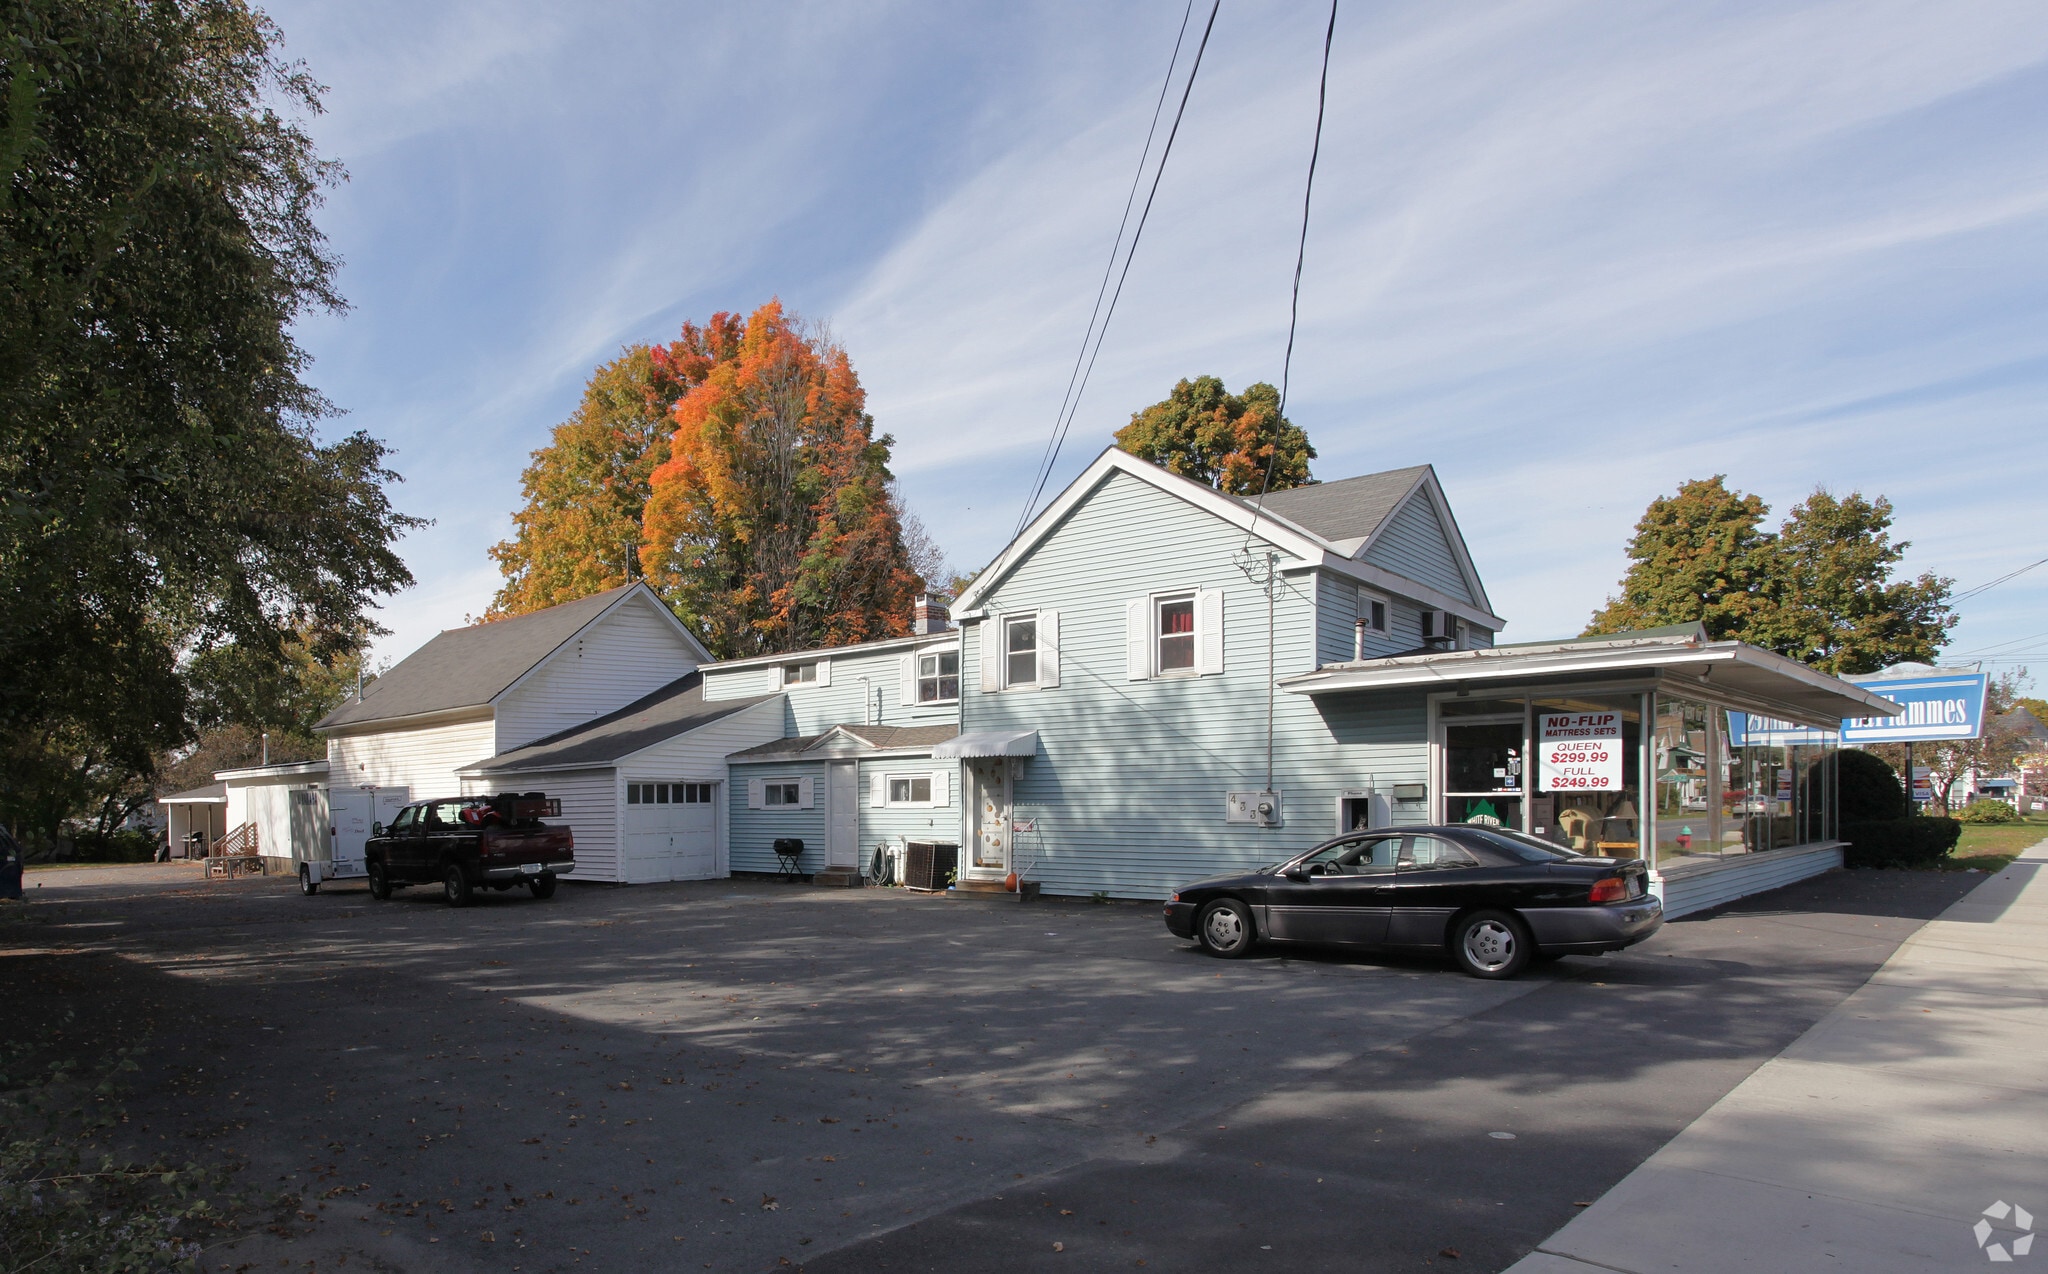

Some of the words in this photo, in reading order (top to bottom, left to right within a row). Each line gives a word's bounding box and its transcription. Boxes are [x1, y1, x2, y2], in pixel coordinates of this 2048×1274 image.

[1547, 715, 1614, 728] NO-FLIP
[1545, 728, 1590, 737] MATTRESS
[1593, 727, 1617, 735] SETS
[1557, 742, 1602, 751] QUEEN
[1550, 752, 1609, 764] $299.99
[1563, 767, 1596, 775] FULL
[1551, 777, 1609, 788] $249.99
